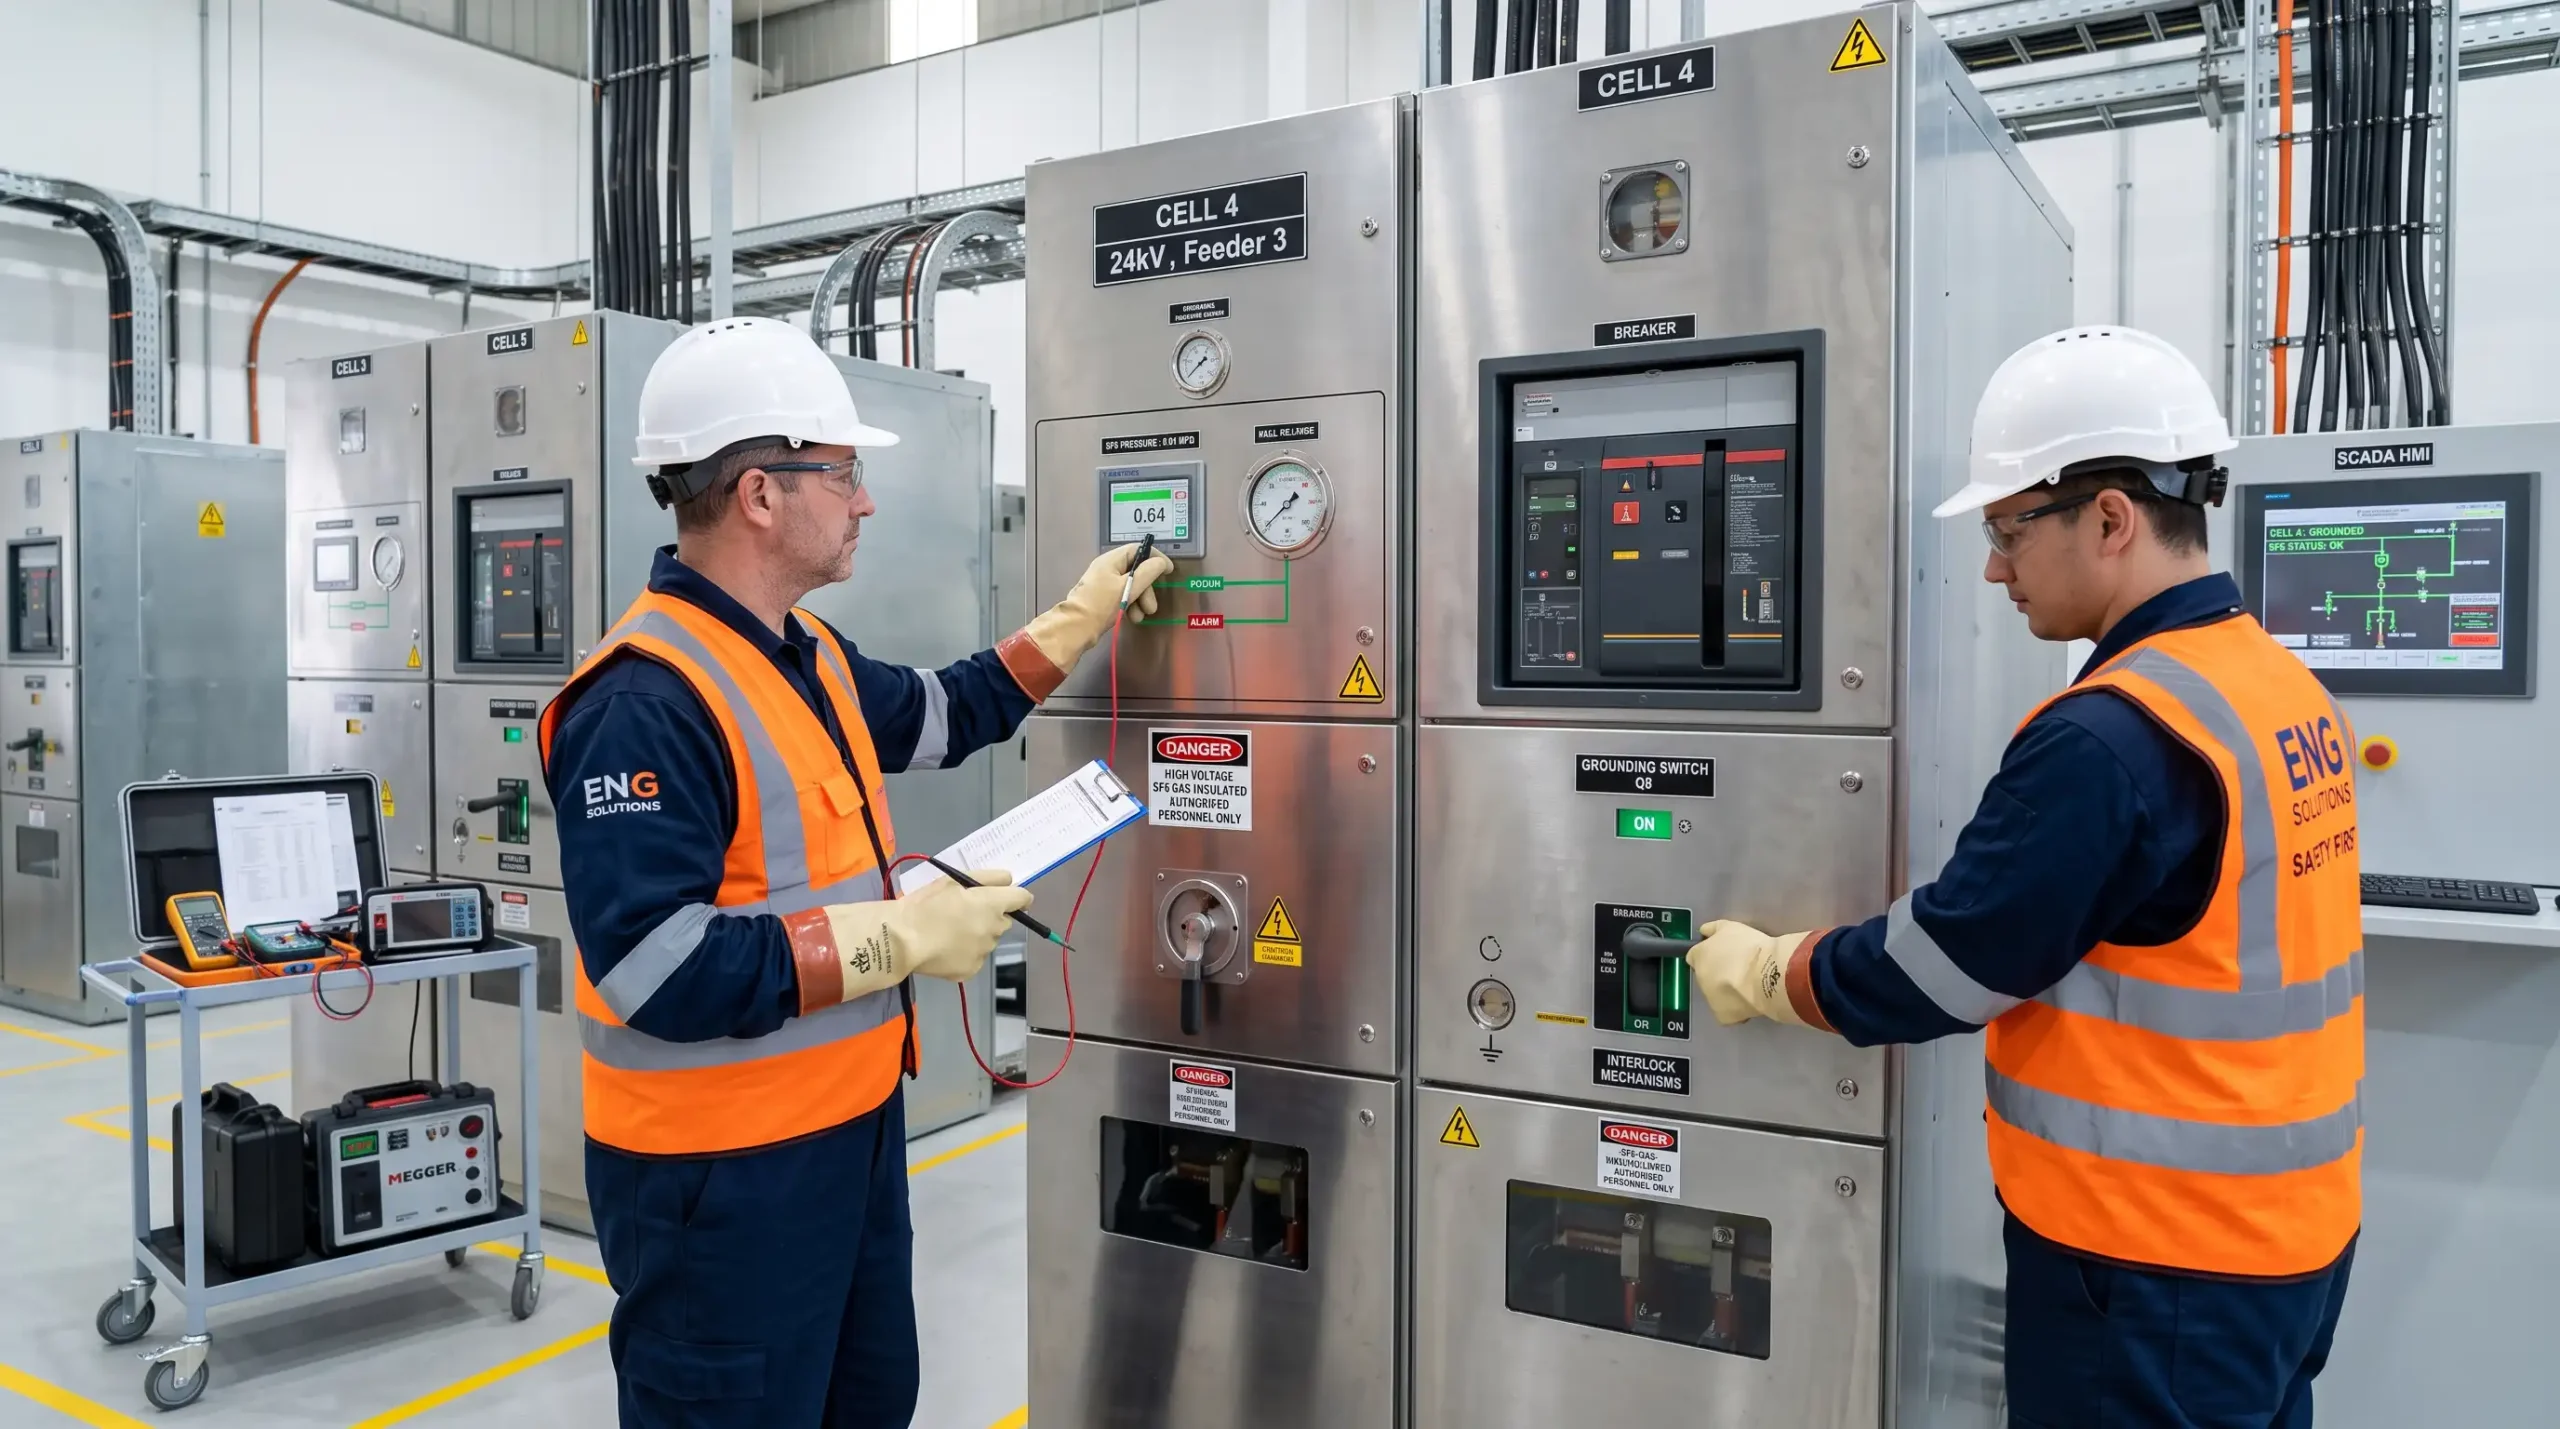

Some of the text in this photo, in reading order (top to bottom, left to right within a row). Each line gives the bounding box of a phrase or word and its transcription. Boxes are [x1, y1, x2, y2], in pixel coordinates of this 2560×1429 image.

[1598, 58, 1695, 97] CELL 4
[1156, 193, 1239, 227] CELL 4
[1184, 233, 1266, 265] Feeder
[1273, 227, 1287, 252] 3
[1614, 321, 1677, 339] BREAKER
[492, 332, 527, 351] CELL 5
[336, 358, 367, 376] CELL 3
[2337, 447, 2430, 465] SCADA HMI
[1133, 507, 1165, 523] 0.64
[2269, 528, 2293, 538] CELL
[2309, 526, 2365, 537] GROUNDED
[2288, 542, 2326, 551] STATUS:
[2329, 541, 2345, 550] OK
[1190, 617, 1220, 626] ALARM
[1166, 741, 1232, 757] DANGER
[2275, 716, 2343, 792] ENG
[1164, 769, 1234, 781] HIGH VOLTAGE
[1581, 758, 1709, 775] GROUNDING SWITCH
[583, 771, 659, 805] ENG
[1152, 782, 1247, 797] SF6 GAS INSULATED
[1635, 777, 1652, 790] Q8
[586, 801, 661, 819] SOLUTIONS
[2293, 782, 2351, 826] SOLUTIONS
[1158, 809, 1242, 824] PERSONNEL ONLY
[1633, 816, 1655, 831] ON
[1634, 1019, 1649, 1029] OR
[1667, 1021, 1684, 1032] ON
[1607, 1054, 1676, 1074] INTERLOCK
[1180, 1069, 1225, 1084] DANGER
[1600, 1068, 1682, 1090] MECHANISMS
[1174, 1111, 1230, 1126] PERSONNEL ONLY
[1610, 1127, 1668, 1145] DANGER
[388, 1161, 457, 1185] MEGGER
[1614, 1168, 1664, 1182] AUTHORISED
[1603, 1176, 1674, 1193] PERSONNEL ONLY
